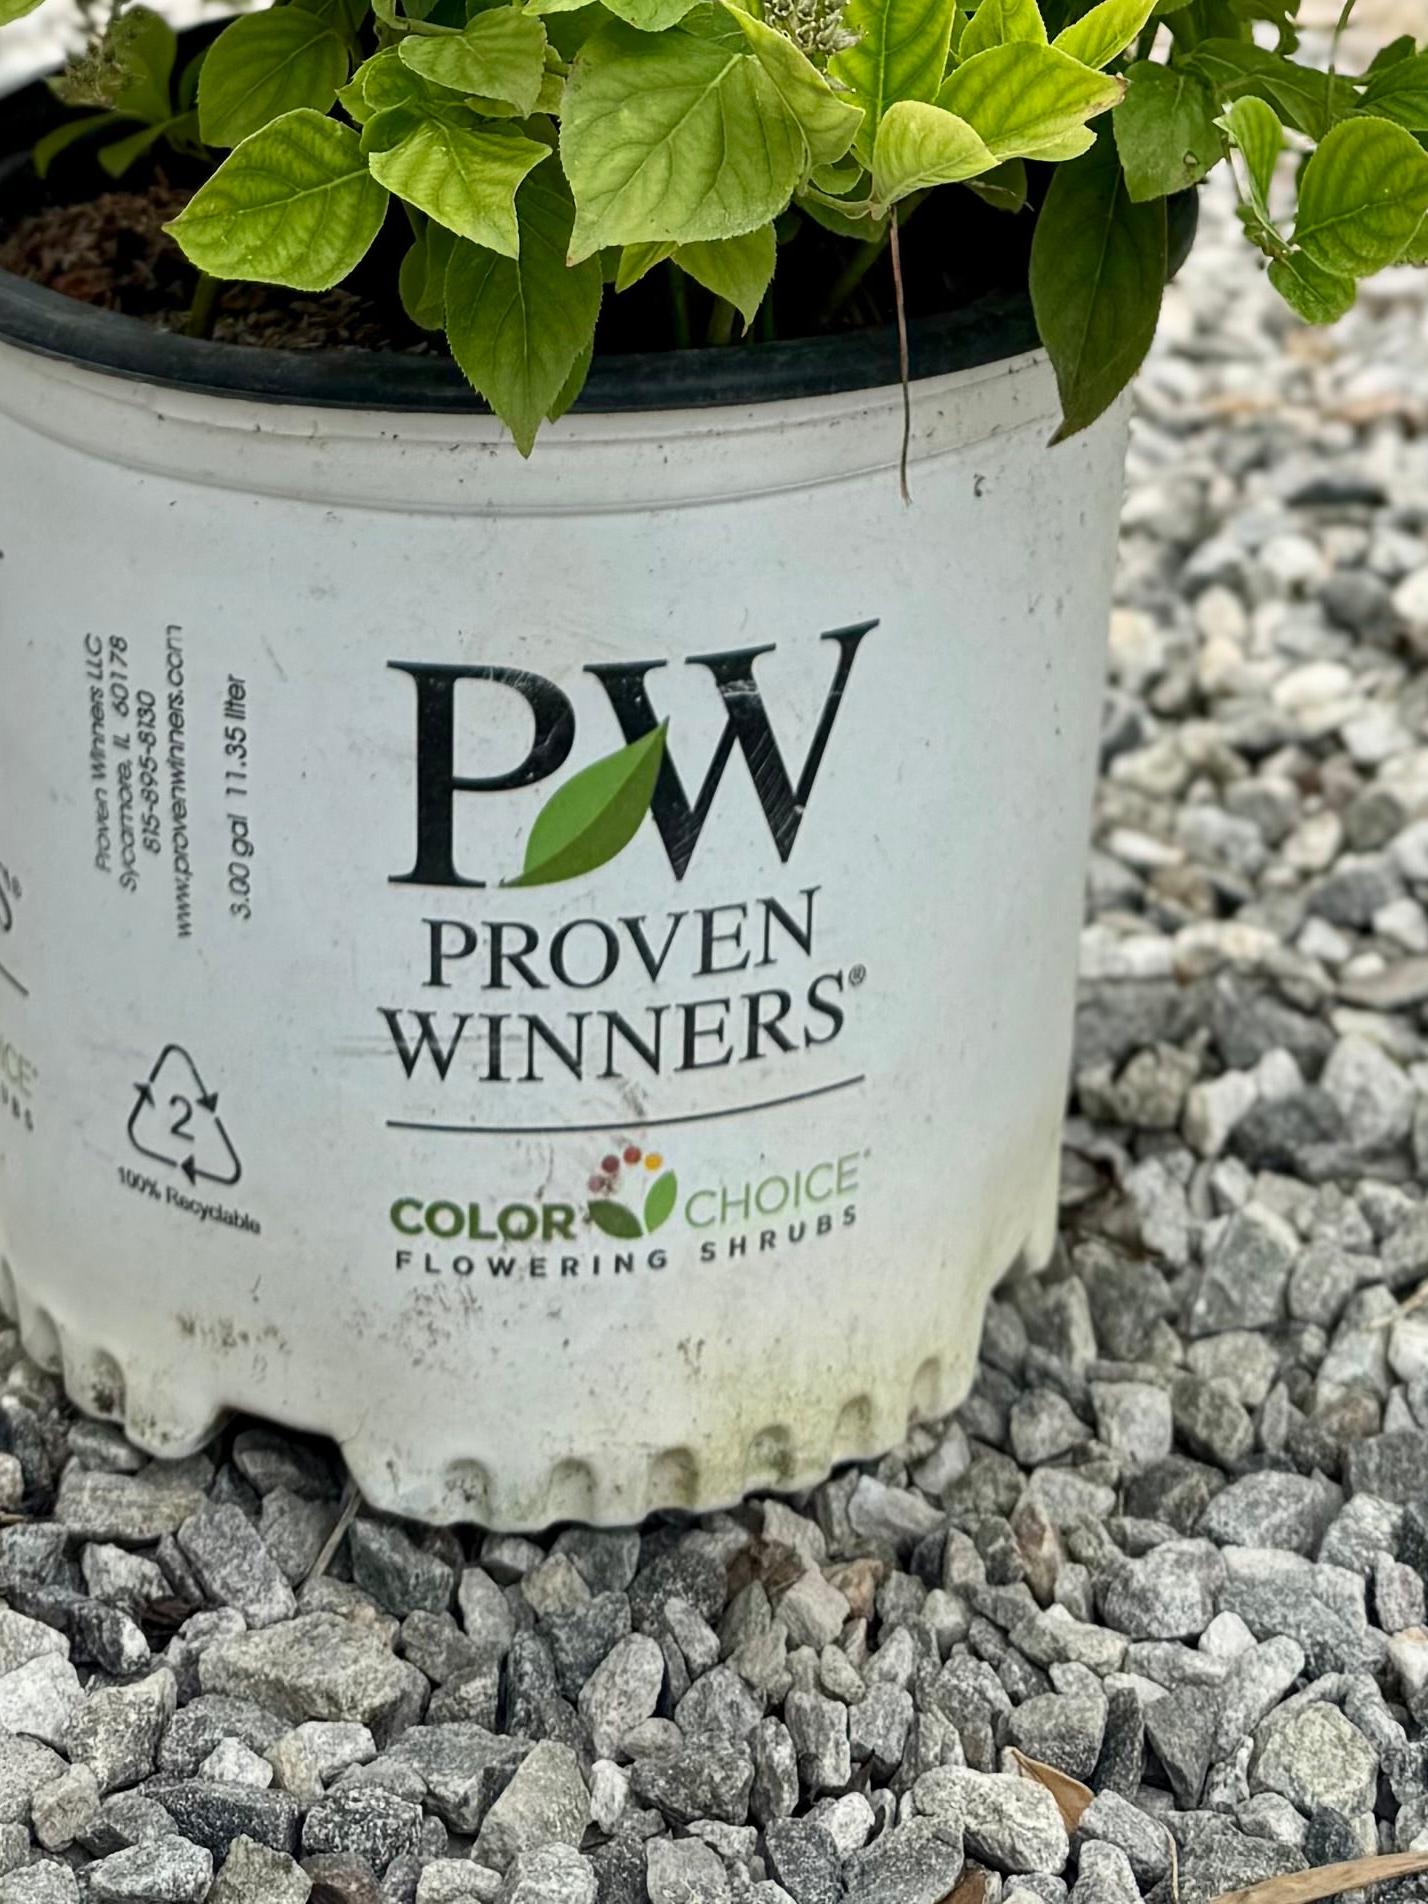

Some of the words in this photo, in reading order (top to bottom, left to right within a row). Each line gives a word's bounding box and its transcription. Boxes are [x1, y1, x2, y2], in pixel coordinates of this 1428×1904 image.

[84, 633, 104, 681] LLC
[109, 635, 129, 718] 60178
[89, 685, 107, 780] Winners
[112, 733, 131, 751] IL
[224, 726, 248, 796] 11.35
[386, 618, 880, 889] PW
[136, 689, 162, 855] 815-895-8130
[166, 623, 194, 939] www.provenwinners.com
[94, 787, 112, 875] Proven
[116, 758, 140, 893] Sycamore,
[227, 813, 254, 858] gal
[227, 861, 252, 920] 3.00
[421, 885, 822, 990] PROVEN
[170, 1094, 195, 1142] 2
[117, 1165, 162, 1202] 100%
[166, 1186, 261, 1235] Recyclable
[389, 1196, 578, 1242] COLOR
[394, 1248, 669, 1279] FLOWERING
[699, 1204, 859, 1263] SHRUBS
